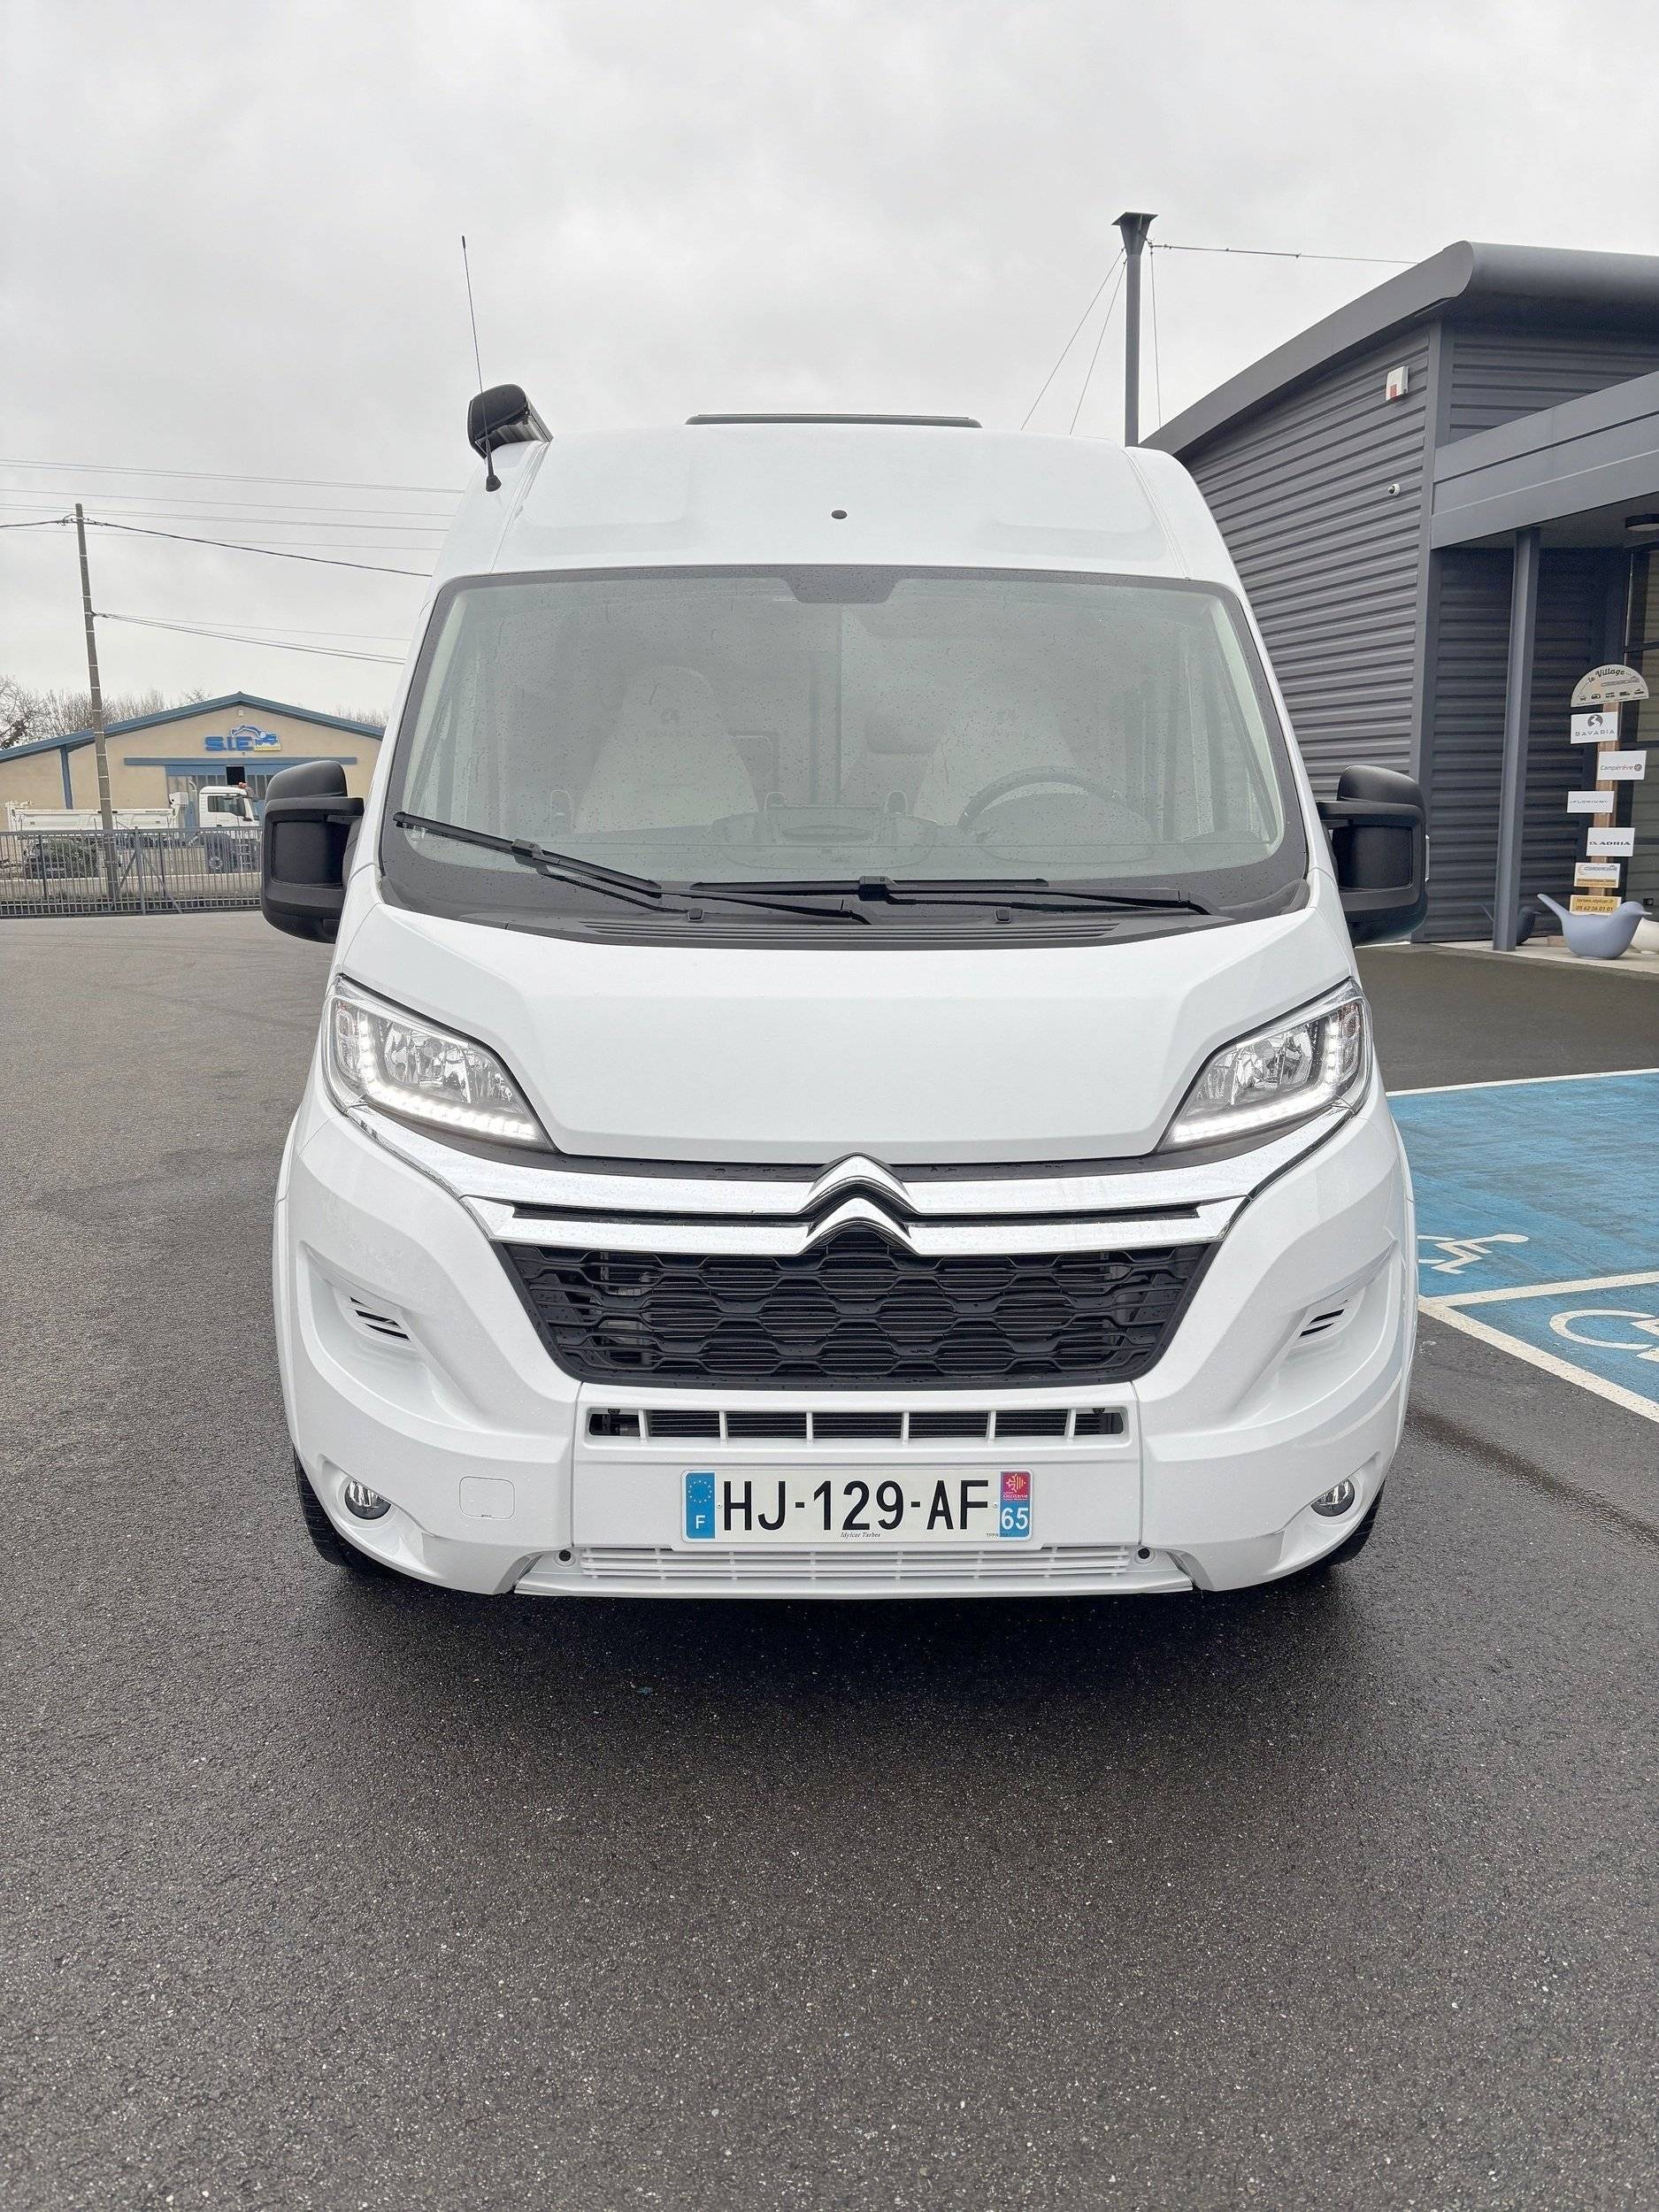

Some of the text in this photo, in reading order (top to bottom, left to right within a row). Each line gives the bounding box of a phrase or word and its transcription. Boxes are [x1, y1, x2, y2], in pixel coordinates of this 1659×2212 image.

[1595, 668, 1625, 677] Village
[723, 1479, 988, 1531] HJ-129-AF
[695, 1515, 705, 1529] F
[1001, 1507, 1028, 1530] 65
